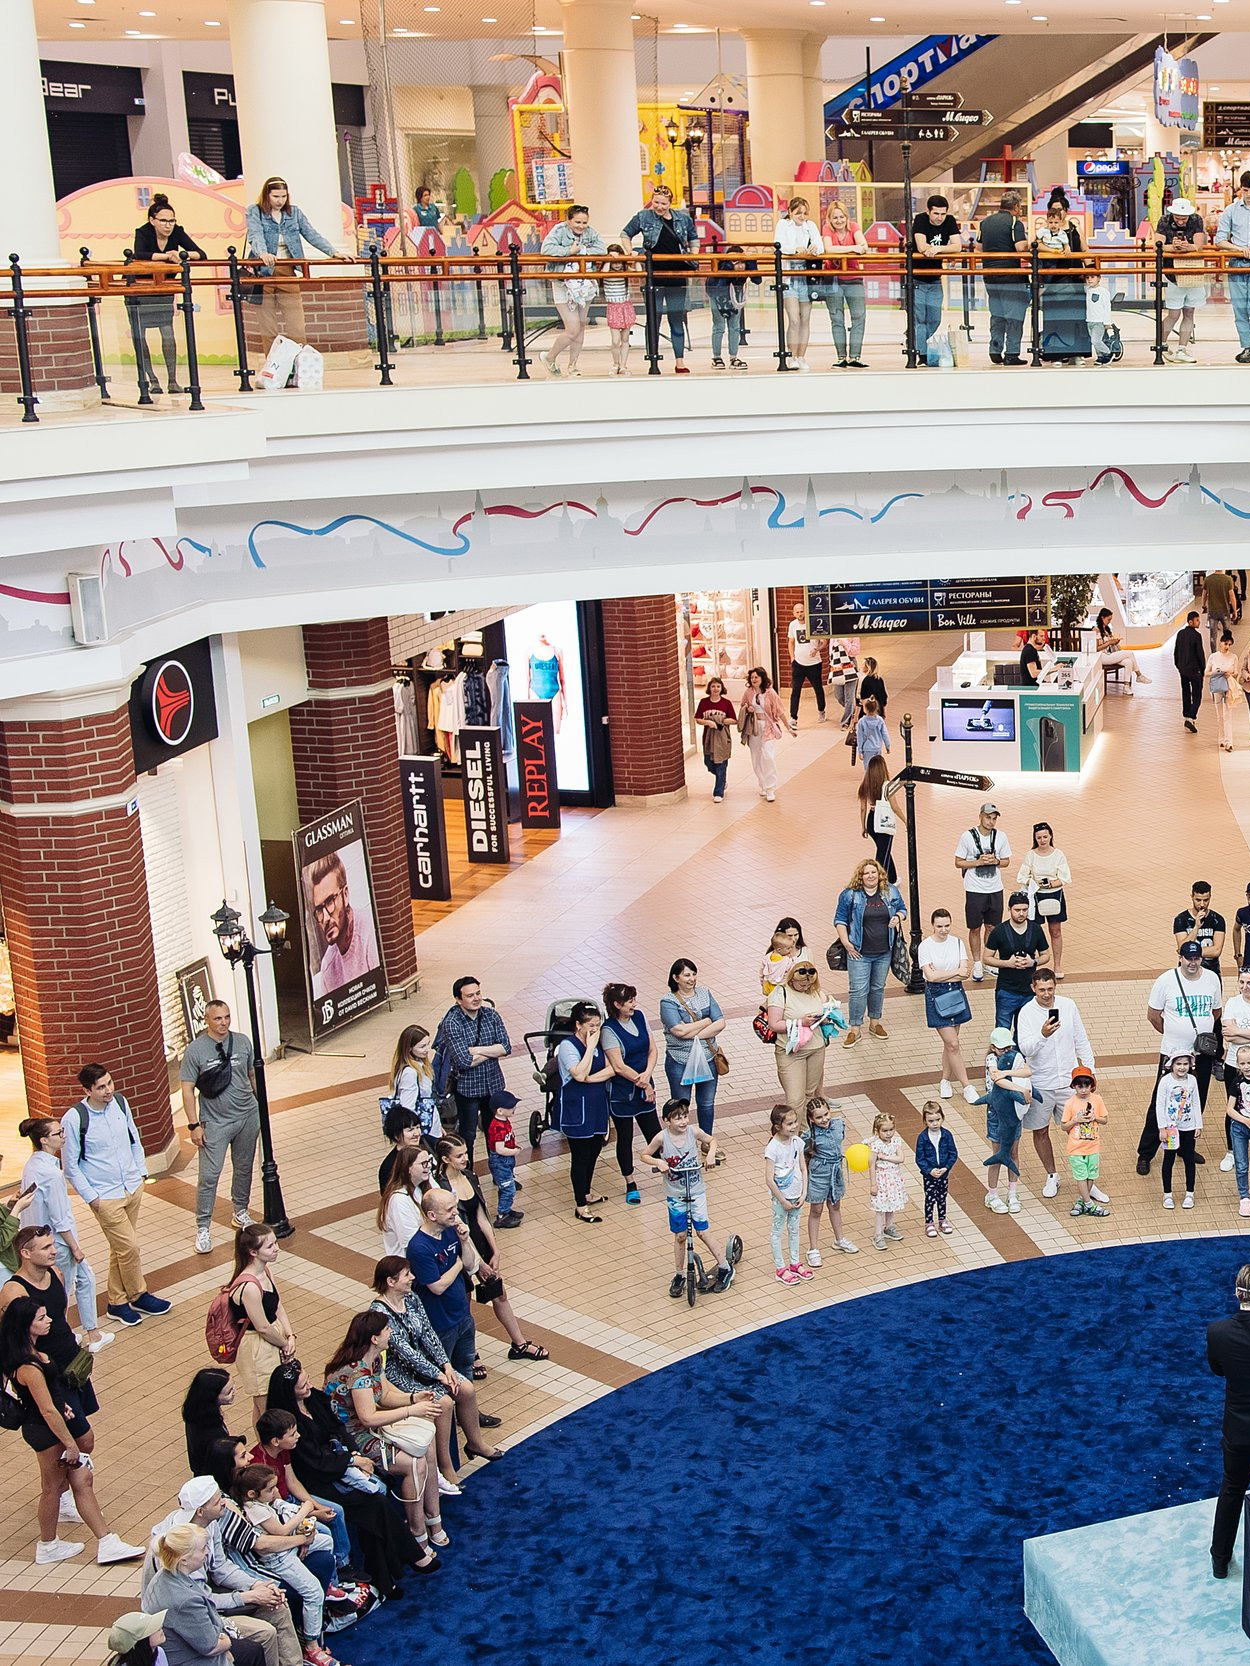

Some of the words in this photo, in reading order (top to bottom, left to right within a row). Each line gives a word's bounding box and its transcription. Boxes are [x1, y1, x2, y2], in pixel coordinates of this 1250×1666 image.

[1095, 162, 1120, 172] pepsi
[868, 598, 898, 606] ГАЛЕРЕЯ
[948, 591, 992, 600] РЕСТОРАНЫ
[1034, 588, 1041, 599] 2
[853, 614, 908, 631] М.видео
[937, 613, 956, 627] Bon
[956, 613, 977, 626] Ville
[1034, 609, 1041, 620] 1
[483, 741, 493, 772] LIVING
[520, 714, 550, 819] REPLAY
[468, 741, 489, 853] DIESEL
[486, 773, 497, 833] SUCCESSFUL
[305, 812, 354, 848] GLASSMAN
[408, 772, 434, 889] carhartt
[491, 834, 499, 853] FOR
